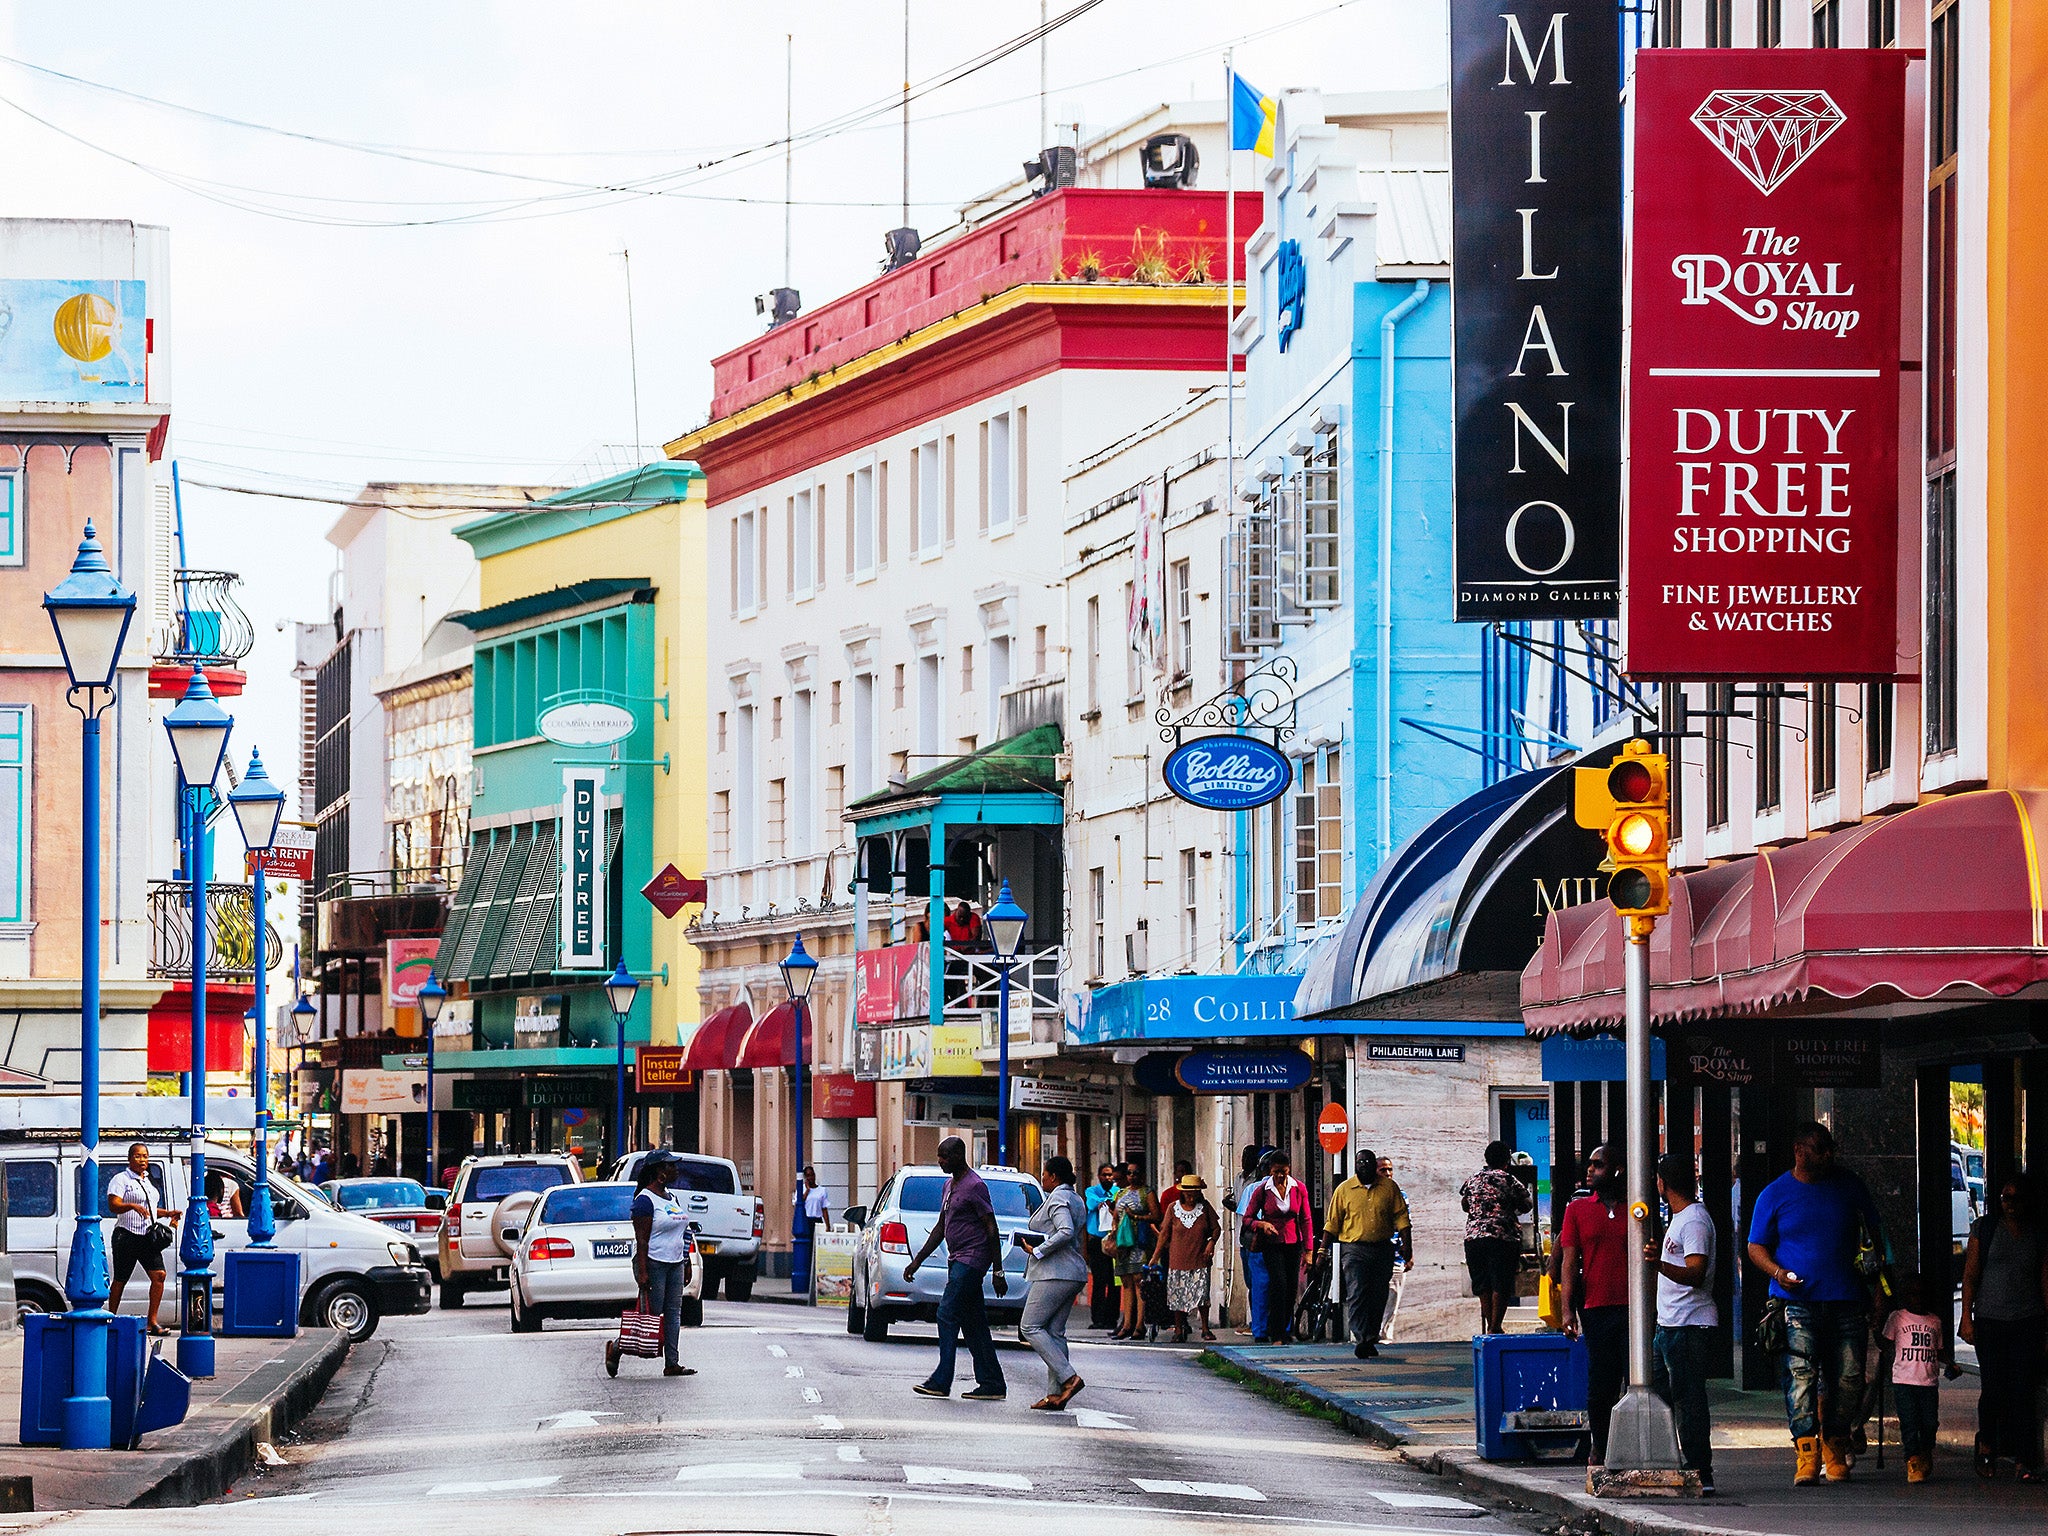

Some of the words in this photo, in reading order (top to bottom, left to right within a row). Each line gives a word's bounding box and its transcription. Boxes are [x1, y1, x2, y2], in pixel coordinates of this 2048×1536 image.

[1741, 226, 1801, 256] The
[1498, 13, 1576, 574] MILANO
[1671, 253, 1855, 326] ROYAL
[1782, 301, 1860, 338] Shop
[1672, 408, 1856, 455] DUTY
[1675, 462, 1852, 517] FREE
[1673, 527, 1852, 554] SHOPPING
[1461, 590, 1539, 602] DIAMOND
[1662, 584, 1720, 605] FINE
[1726, 585, 1863, 610] JEWELLERY
[1688, 611, 1709, 631] &
[1712, 611, 1833, 632] WATCHES
[1186, 751, 1277, 784] Collins
[1203, 782, 1253, 791] LIMITED
[577, 790, 591, 864] DUTY
[280, 848, 309, 860] RENT
[576, 873, 589, 944] FREE
[1147, 997, 1171, 1021] 28
[1193, 995, 1294, 1022] COLLI
[1372, 1046, 1434, 1057] PHILADELPHIA
[1436, 1048, 1459, 1058] LANE
[1563, 1042, 1626, 1051] DIAMON
[1713, 1046, 1733, 1057] The
[1787, 1039, 1830, 1052] DUTY
[647, 1059, 682, 1070] Insta
[1794, 1054, 1862, 1065] SHOPPING
[1689, 1055, 1750, 1080] ROYAL
[648, 1071, 677, 1081] teller
[1726, 1071, 1753, 1083] Shop
[1020, 1080, 1033, 1089] La
[1036, 1081, 1078, 1092] Romana
[533, 1093, 565, 1104] DUTY
[596, 1243, 629, 1256] MA4228
[1902, 1323, 1923, 1334] LITTLE
[1911, 1331, 1932, 1347] BIG
